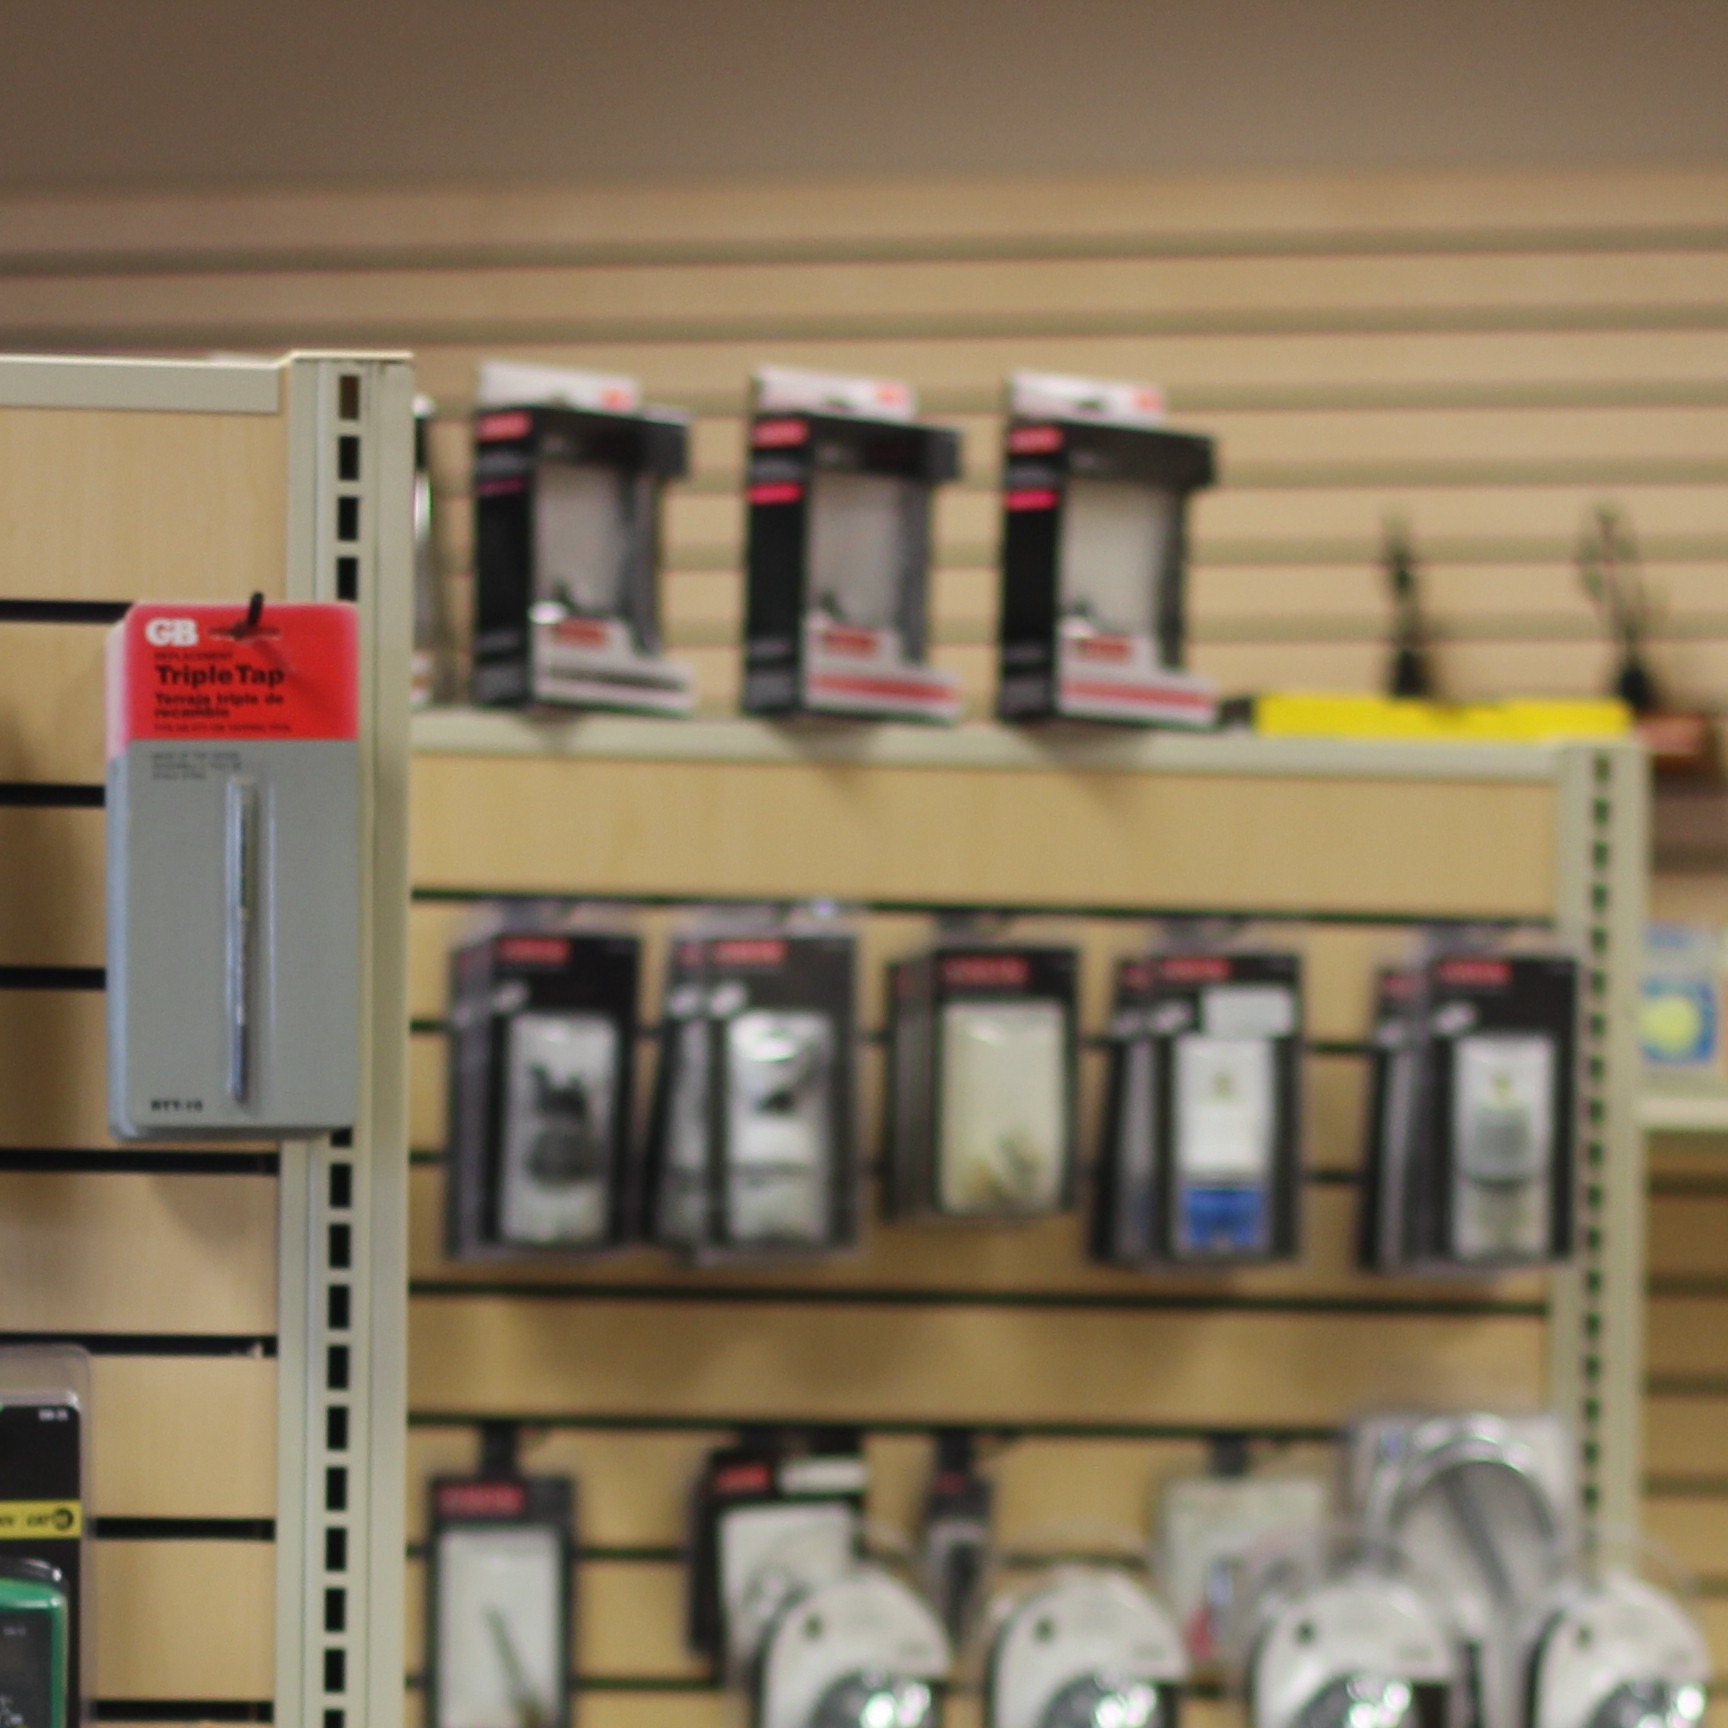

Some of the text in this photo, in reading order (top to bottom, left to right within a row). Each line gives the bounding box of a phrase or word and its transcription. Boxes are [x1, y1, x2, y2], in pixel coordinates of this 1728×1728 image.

[144, 617, 200, 647] GB
[155, 664, 286, 688] Triple Tap
